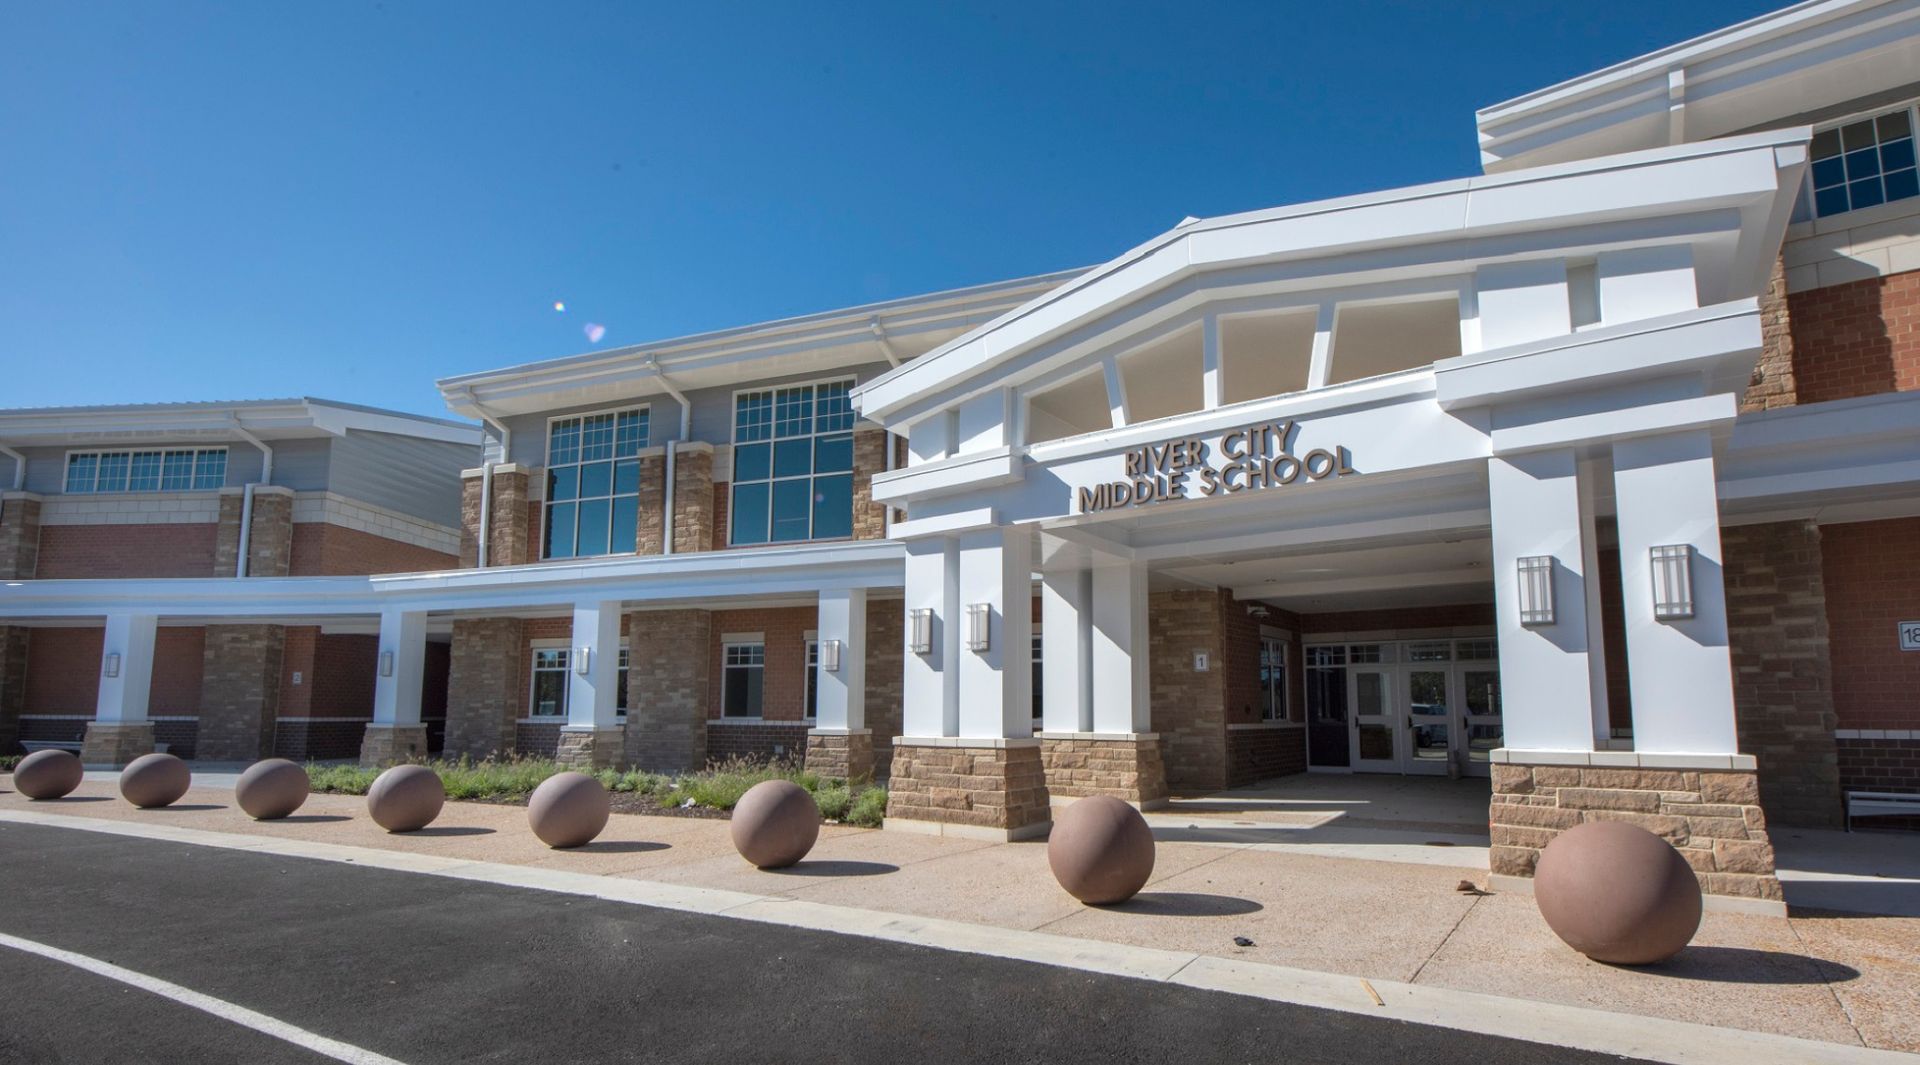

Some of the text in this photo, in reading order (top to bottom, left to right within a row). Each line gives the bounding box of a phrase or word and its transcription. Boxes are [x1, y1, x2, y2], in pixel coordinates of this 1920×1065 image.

[1079, 445, 1352, 513] MIDDLE SCHOOL
[1125, 420, 1294, 476] RIVER CITY
